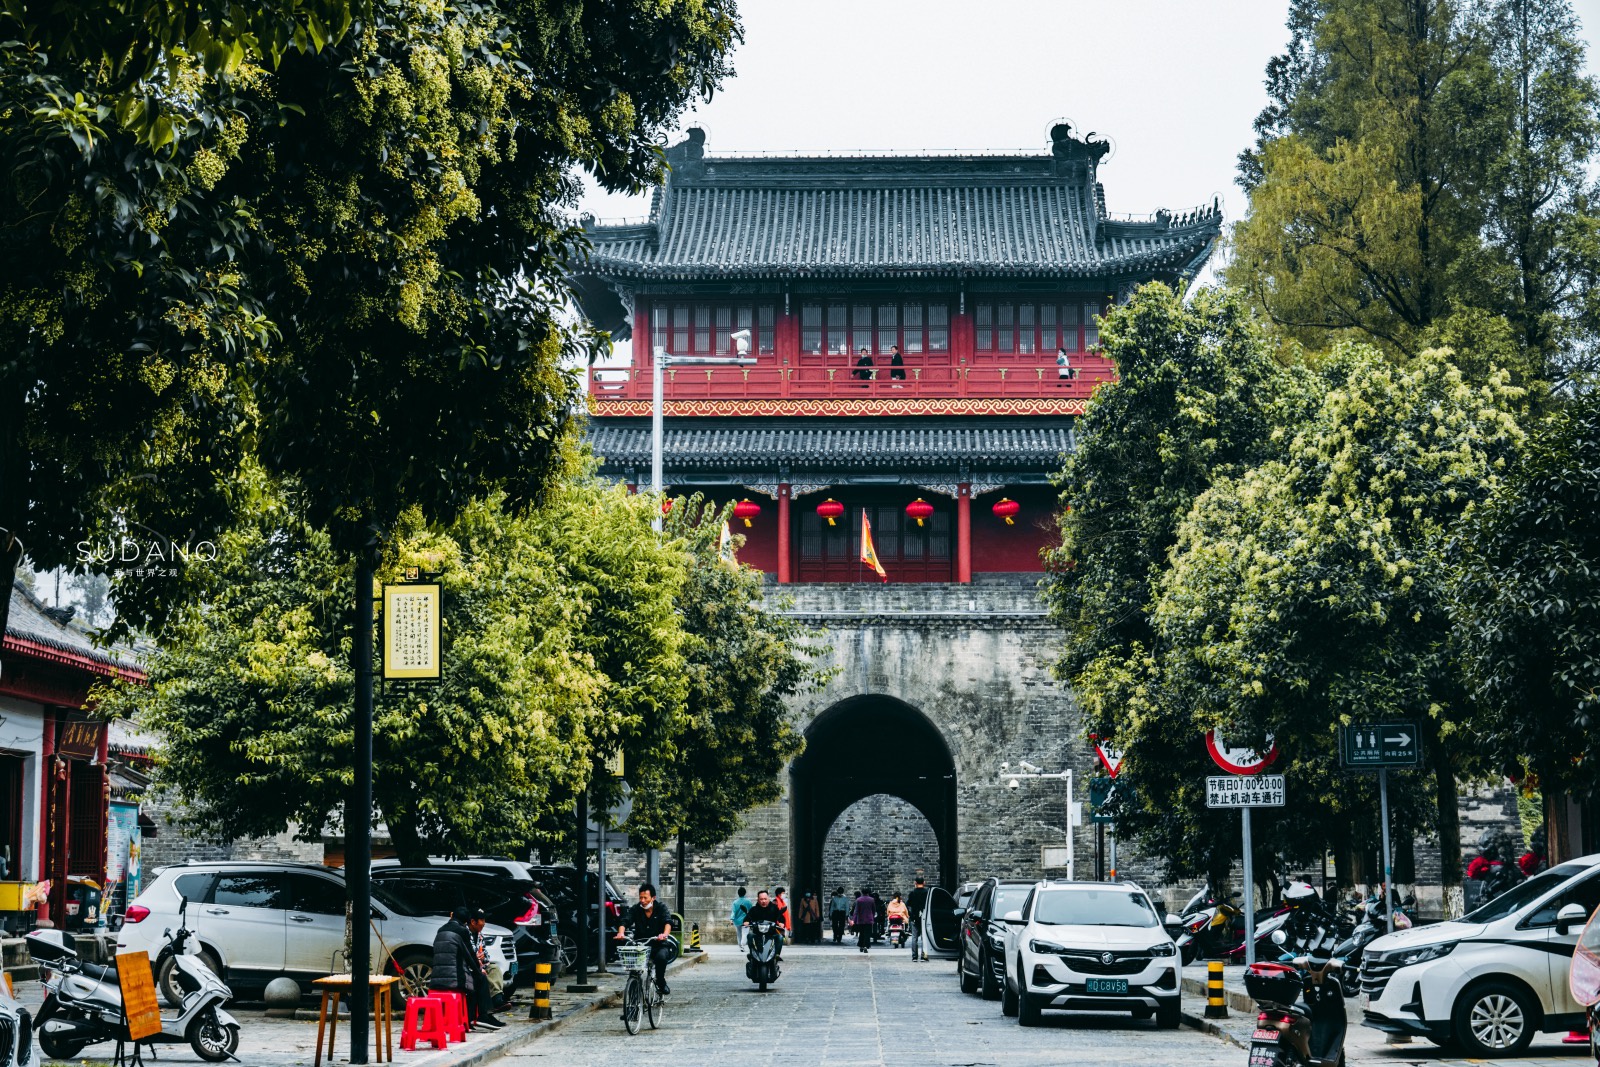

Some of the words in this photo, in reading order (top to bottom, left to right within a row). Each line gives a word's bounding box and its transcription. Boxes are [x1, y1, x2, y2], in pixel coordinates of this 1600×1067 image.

[1209, 791, 1283, 805] 禁止机动车通行
